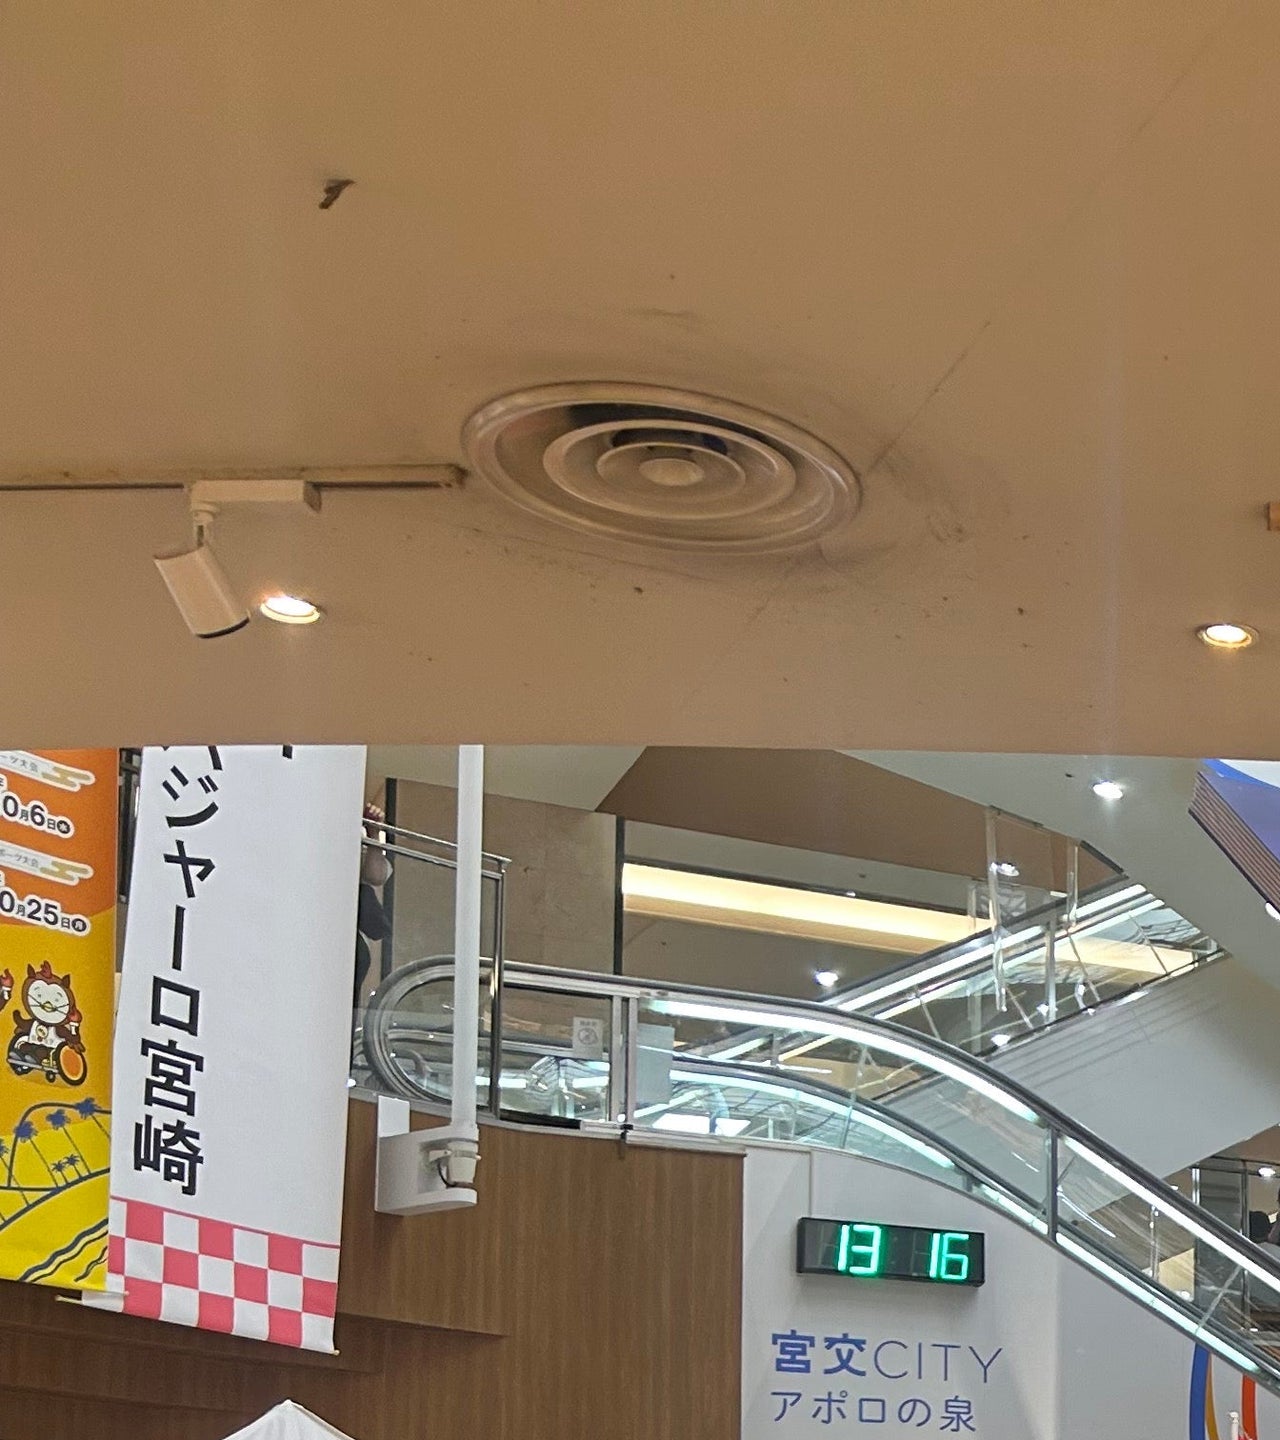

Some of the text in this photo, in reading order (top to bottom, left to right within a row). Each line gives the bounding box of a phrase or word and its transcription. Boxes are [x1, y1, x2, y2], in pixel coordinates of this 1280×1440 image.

[838, 1224, 969, 1281] 13 16
[771, 1330, 1003, 1384] 宮交CITY
[771, 1390, 977, 1432] アポロの泉
